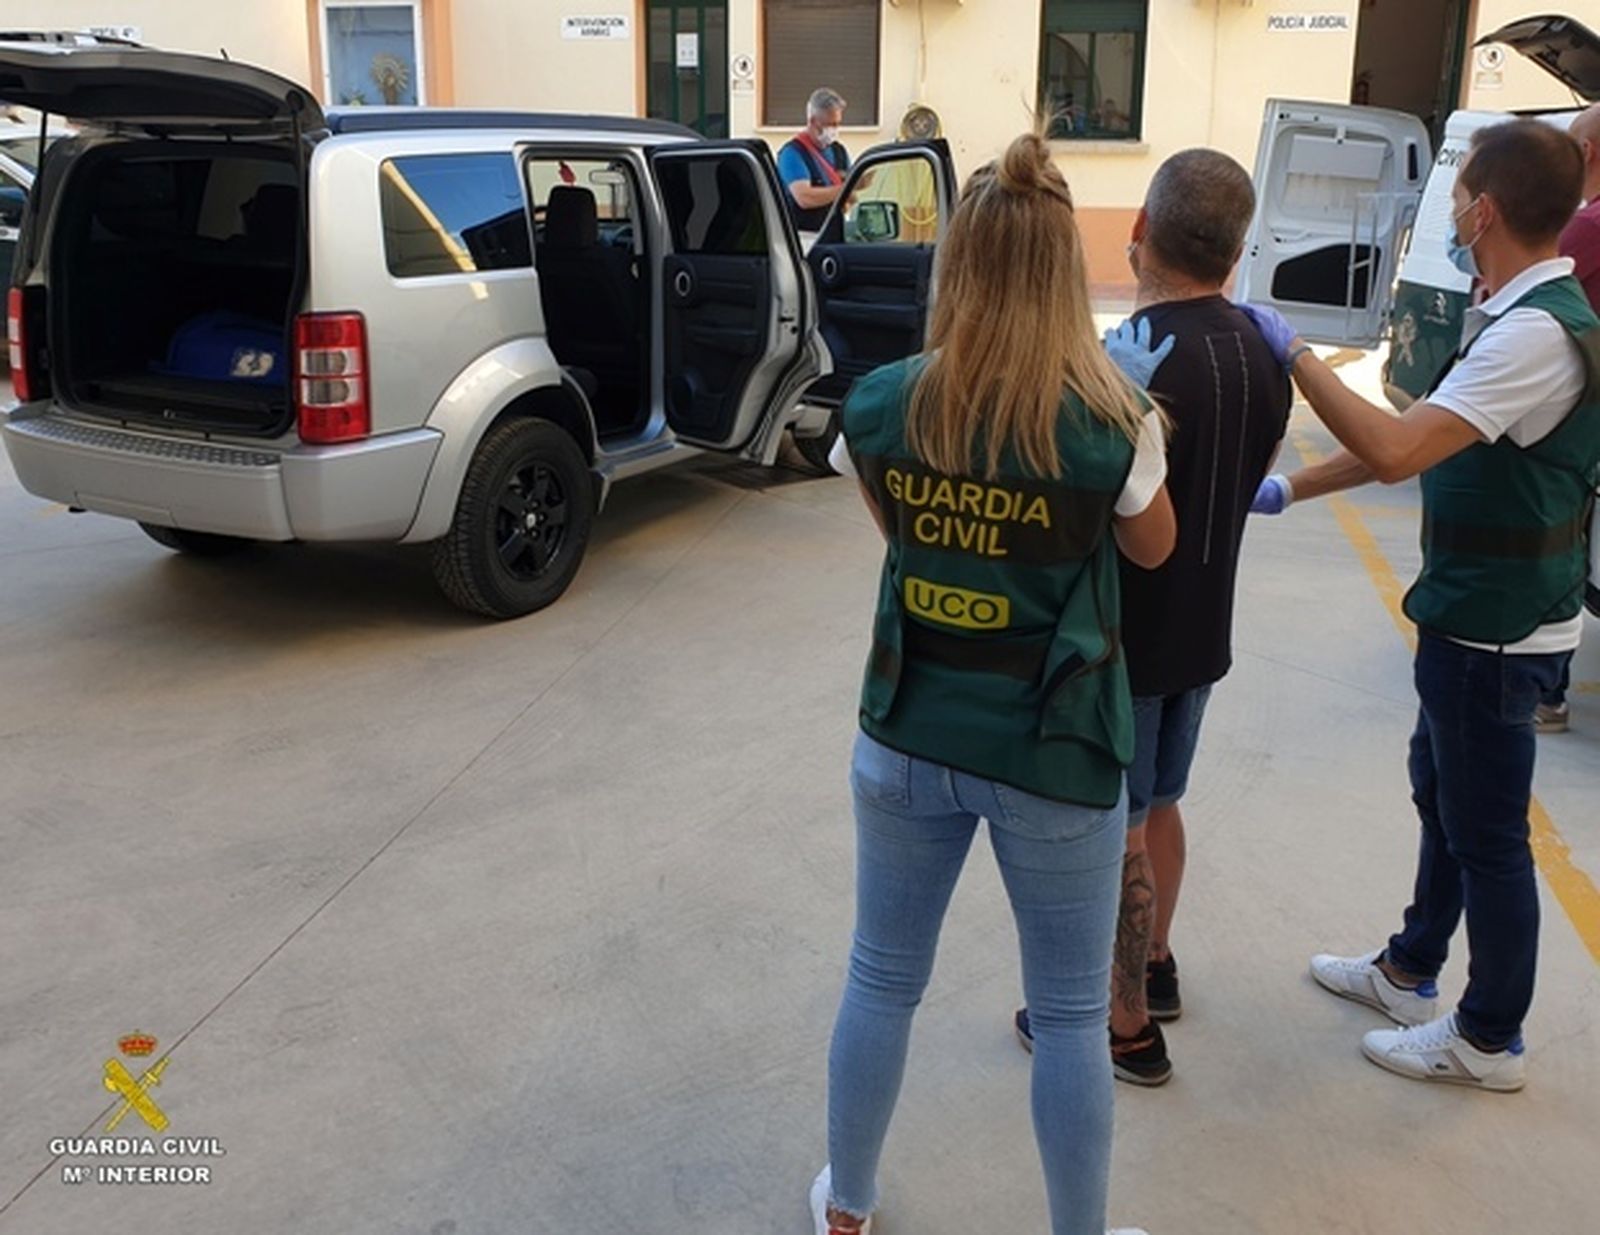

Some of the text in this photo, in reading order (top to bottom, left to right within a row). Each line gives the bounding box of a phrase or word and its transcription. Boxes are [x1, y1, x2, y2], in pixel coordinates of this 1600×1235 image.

[1309, 15, 1348, 29] JUDICIAL
[885, 468, 1051, 529] GUARDIA
[914, 512, 1008, 556] CIVIL
[913, 583, 999, 624] UCO
